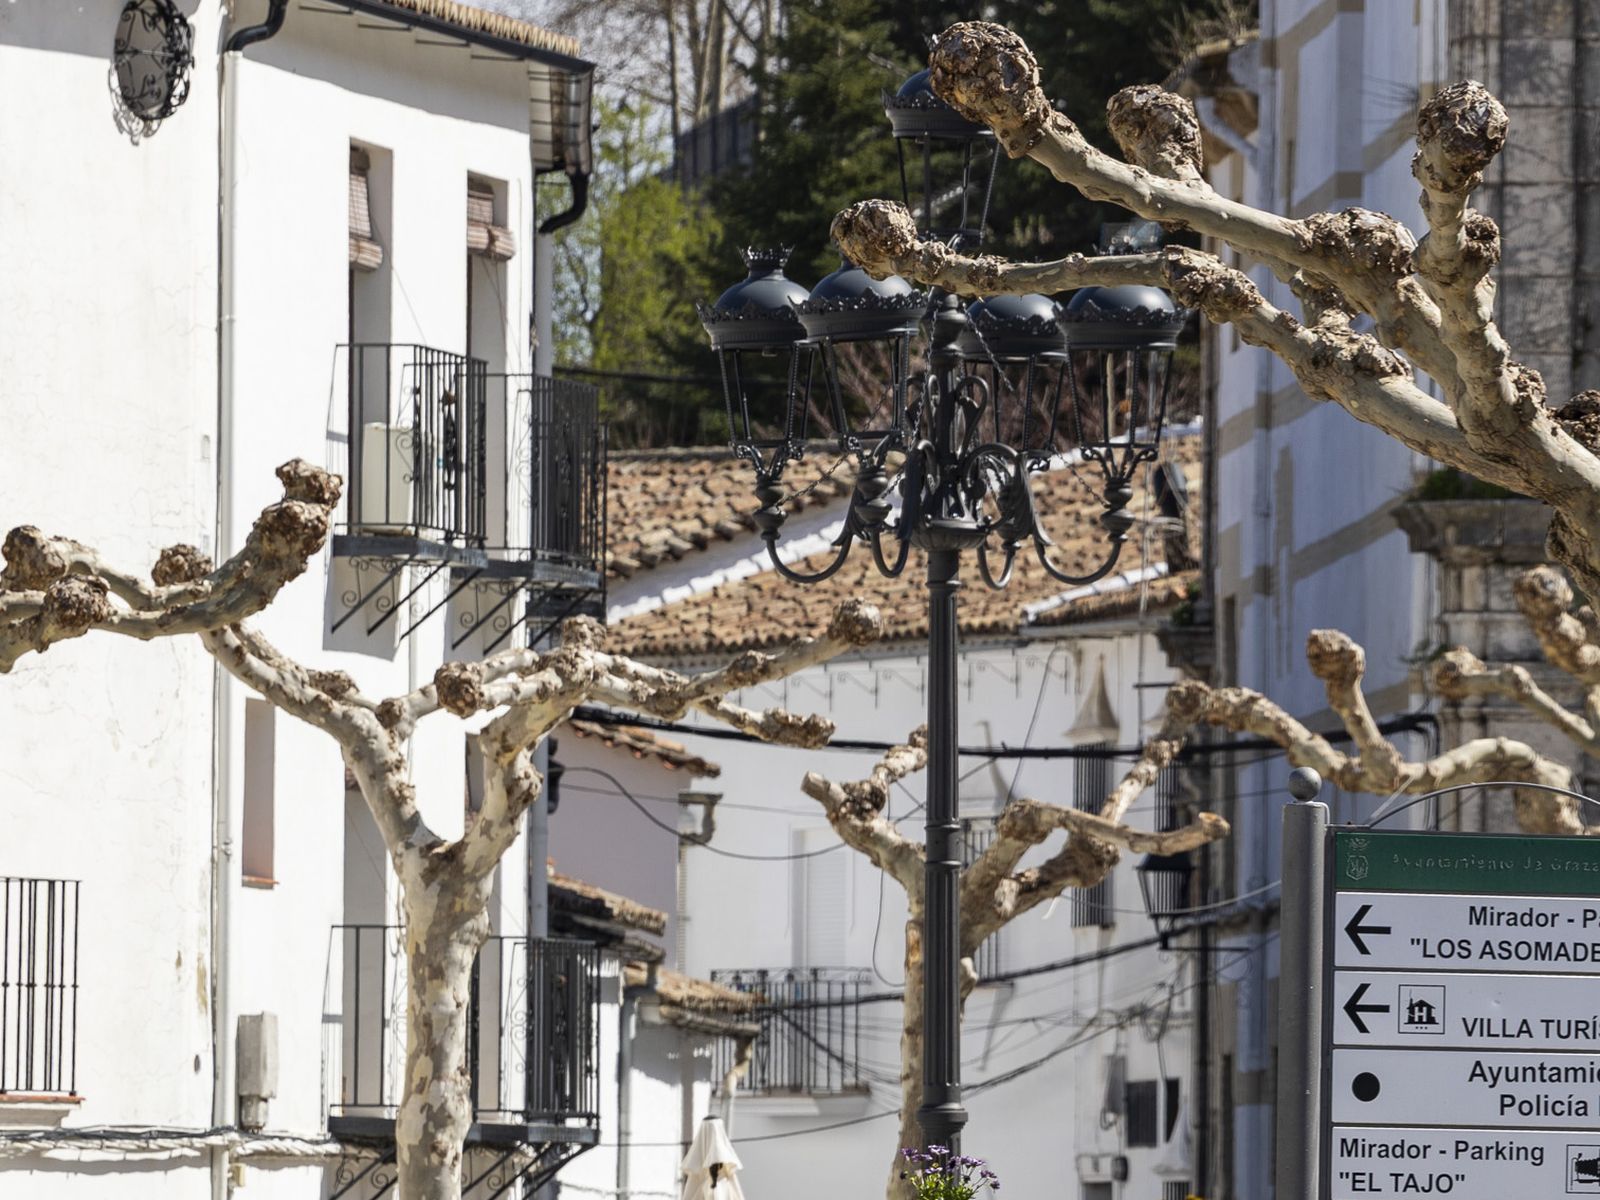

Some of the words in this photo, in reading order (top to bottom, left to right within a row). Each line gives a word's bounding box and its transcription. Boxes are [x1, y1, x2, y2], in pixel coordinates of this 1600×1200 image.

[1468, 905, 1560, 928] Mirador
[1582, 908, 1600, 929] P
[1410, 937, 1472, 960] "LOS
[1478, 939, 1600, 963] ASOMADE
[1461, 1017, 1534, 1039] VILLA
[1540, 1015, 1600, 1040] TURÍ
[1499, 1093, 1589, 1117] Policía
[1340, 1137, 1432, 1160] Mirador
[1454, 1140, 1545, 1167] Parking
[1339, 1171, 1382, 1193] "EL
[1389, 1172, 1465, 1194] TAJO"
